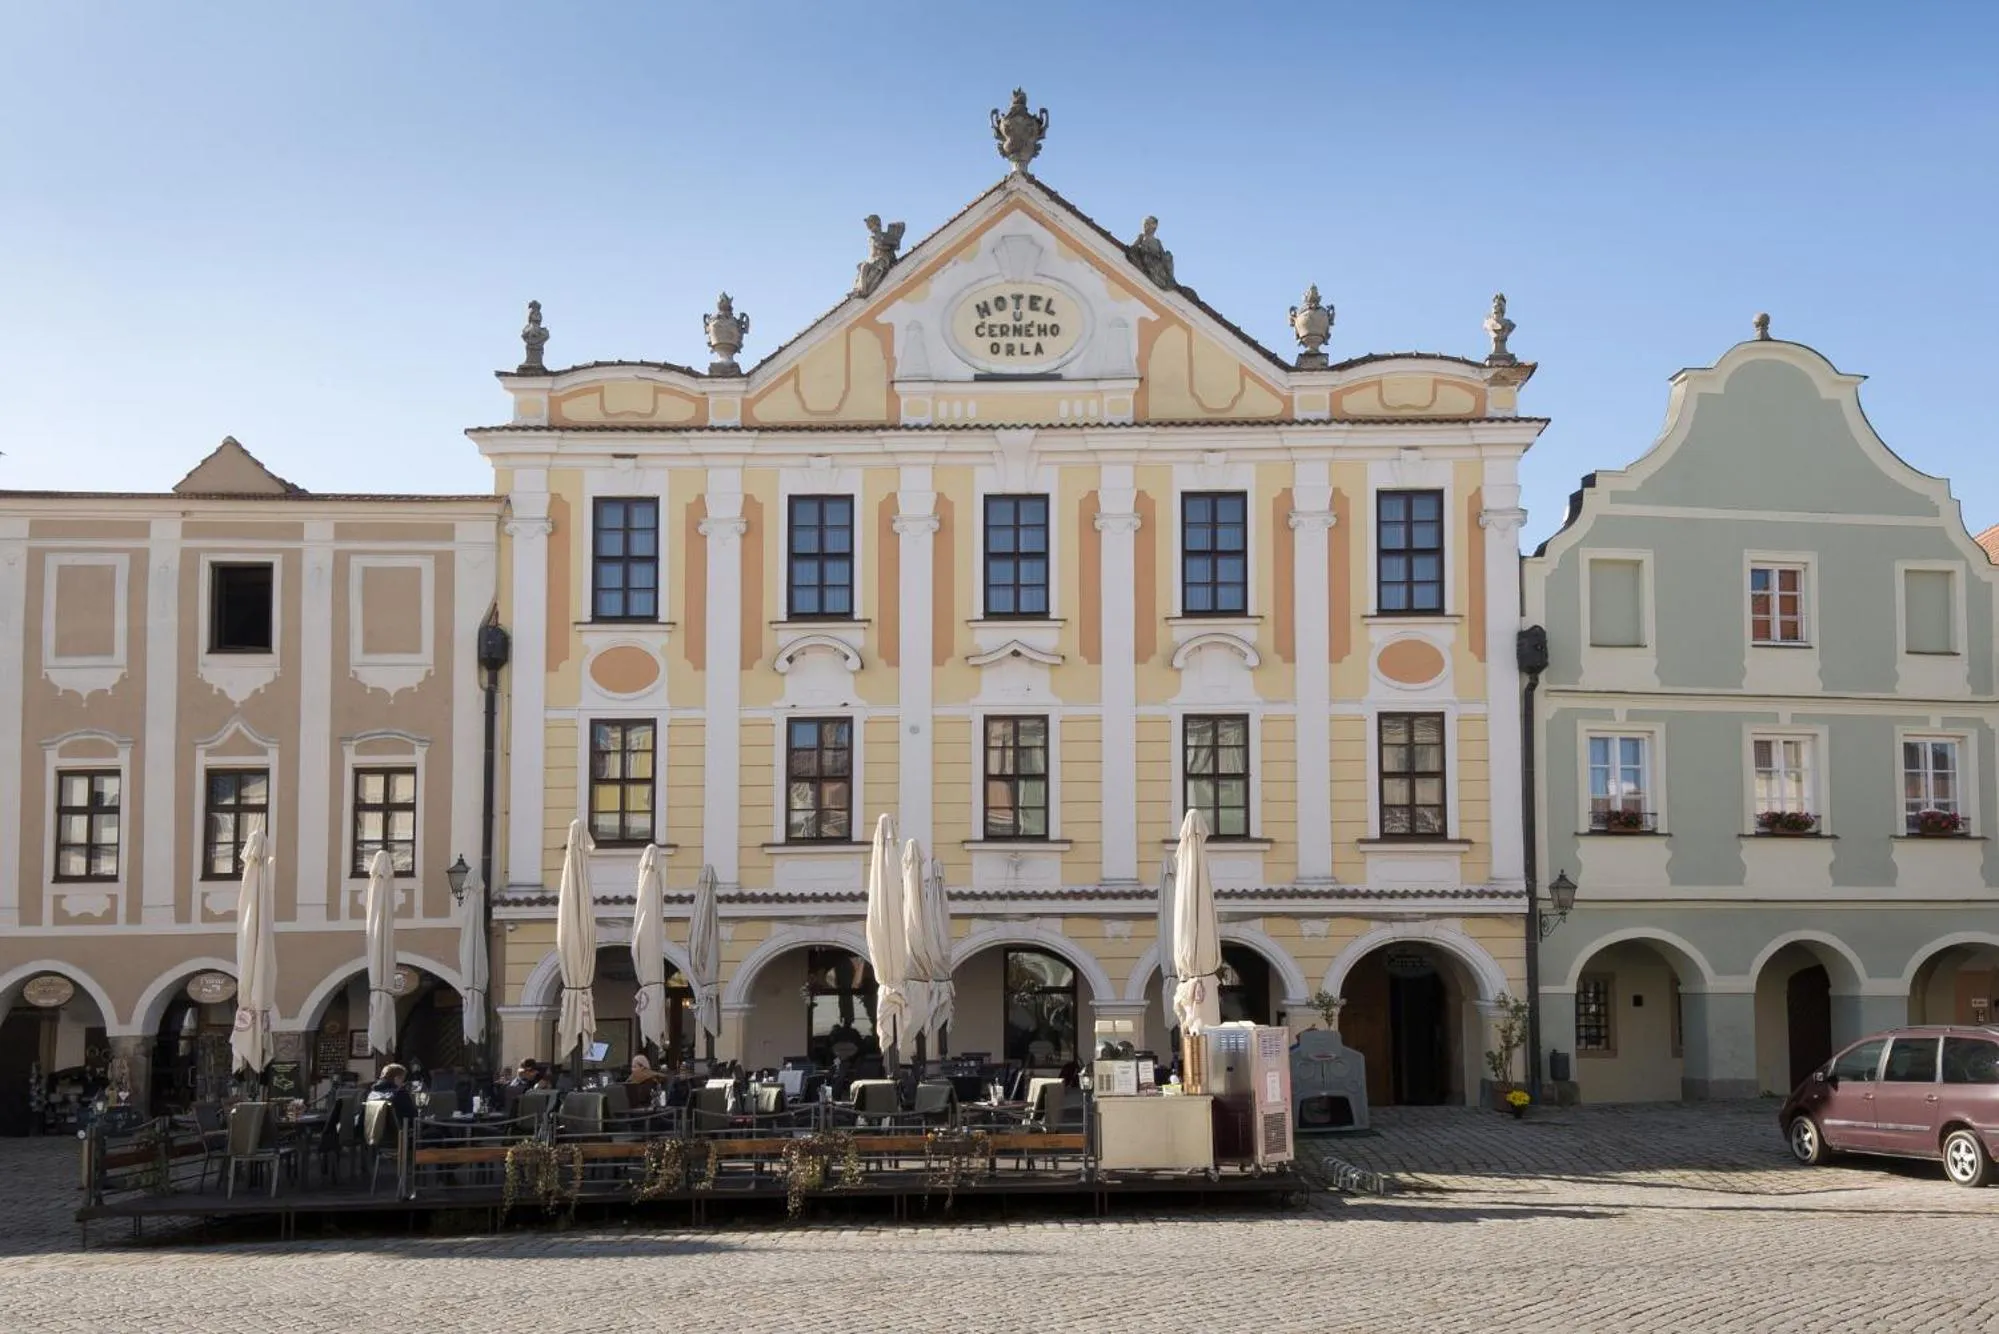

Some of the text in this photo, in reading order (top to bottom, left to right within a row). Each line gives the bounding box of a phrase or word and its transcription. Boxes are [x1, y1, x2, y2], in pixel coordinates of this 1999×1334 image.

[975, 293, 1056, 319] HOTEL
[1012, 310, 1023, 322] U
[990, 341, 1044, 357] ORLA
